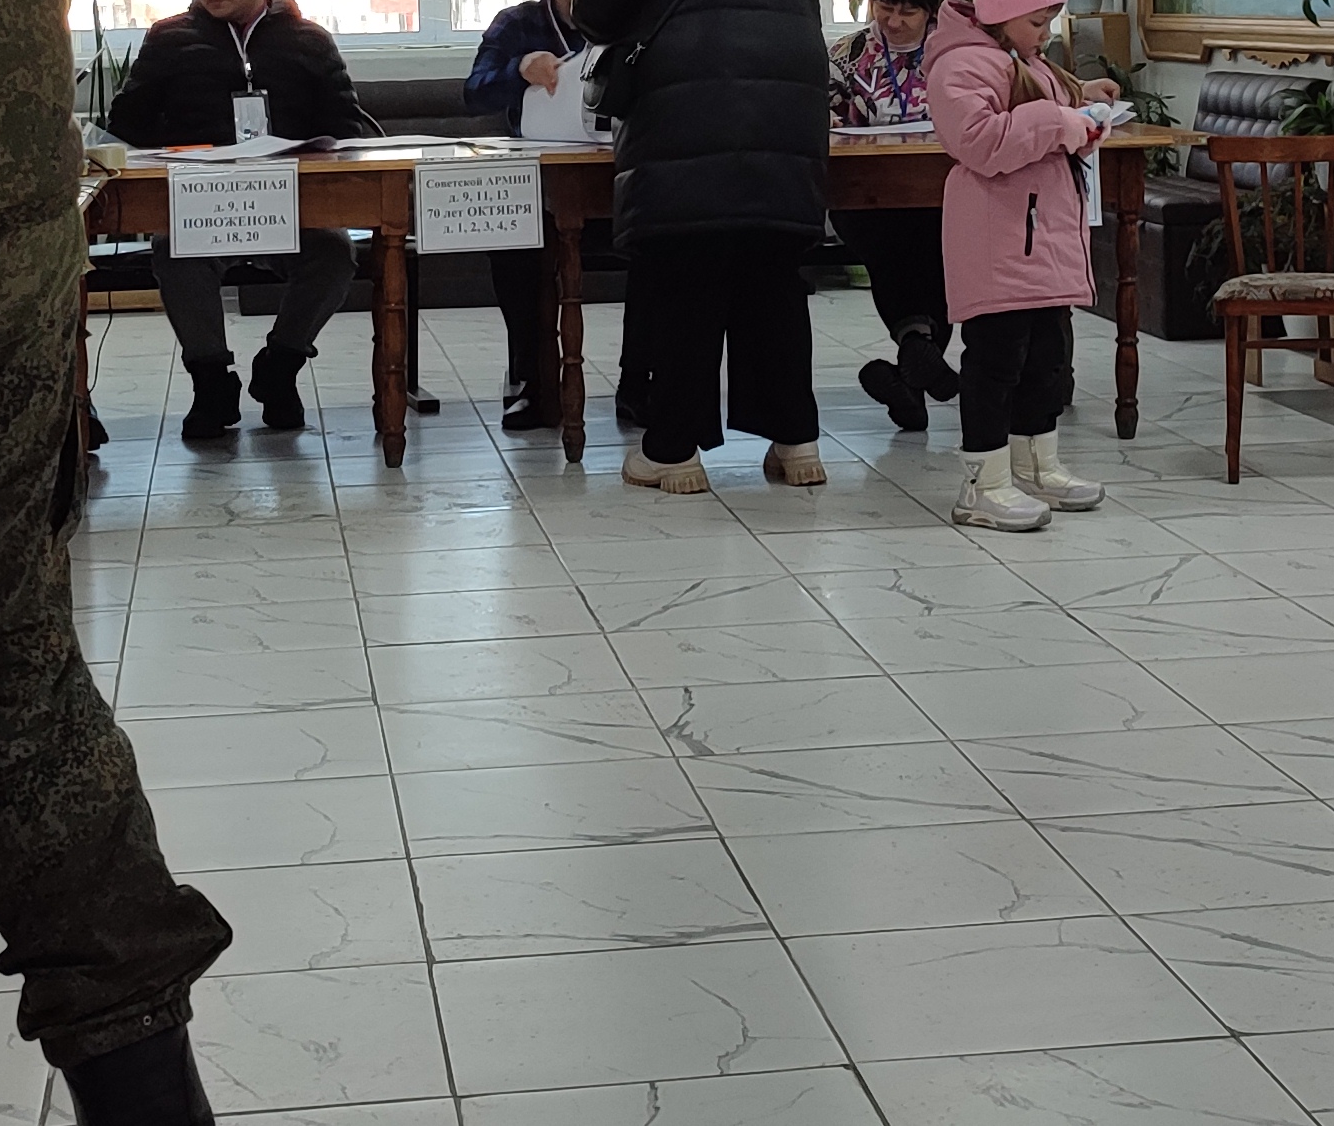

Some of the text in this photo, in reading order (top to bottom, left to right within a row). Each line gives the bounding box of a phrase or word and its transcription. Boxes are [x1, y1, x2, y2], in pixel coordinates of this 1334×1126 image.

[180, 179, 287, 194] МОЛОДЕЖНАЯ
[426, 174, 531, 189] Советской АРМИИ
[449, 189, 509, 203] д. 9, 11, 13
[213, 200, 255, 213] д. 9, 14
[427, 204, 532, 219] 70 лет ОКТЯБРЯ
[183, 214, 287, 229] НОВОЖЕНОВА
[443, 219, 518, 234] д. 1, 2, 3, 4, 5
[211, 231, 259, 244] д. 18, 20
